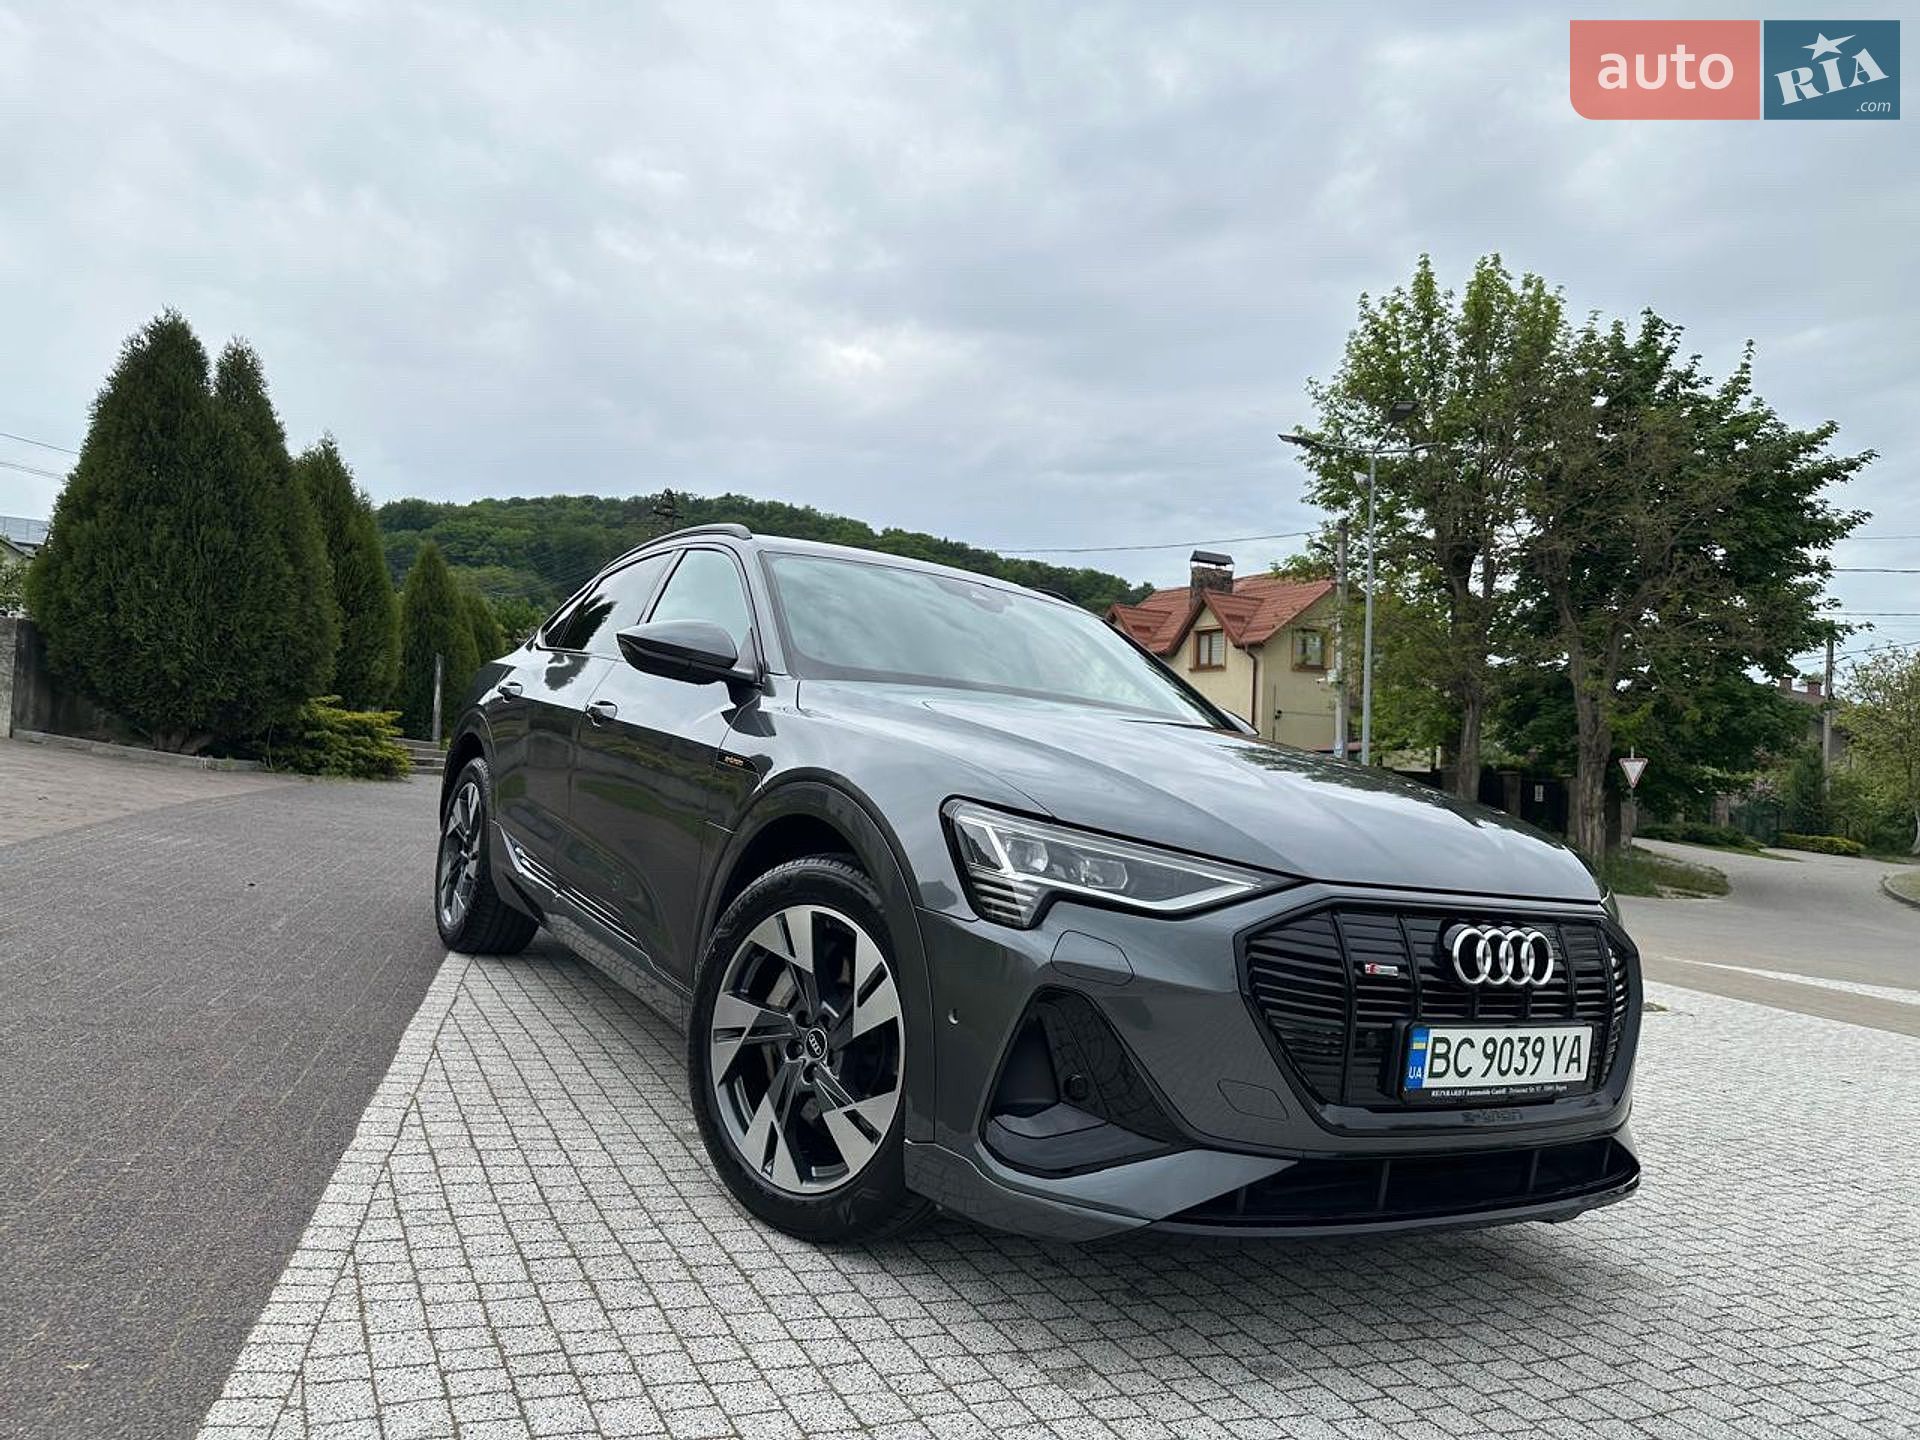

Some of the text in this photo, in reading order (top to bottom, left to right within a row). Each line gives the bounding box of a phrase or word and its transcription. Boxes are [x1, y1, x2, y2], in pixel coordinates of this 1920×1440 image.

[1428, 1035, 1582, 1079] BC 9039 YA
[1408, 1065, 1422, 1079] UA
